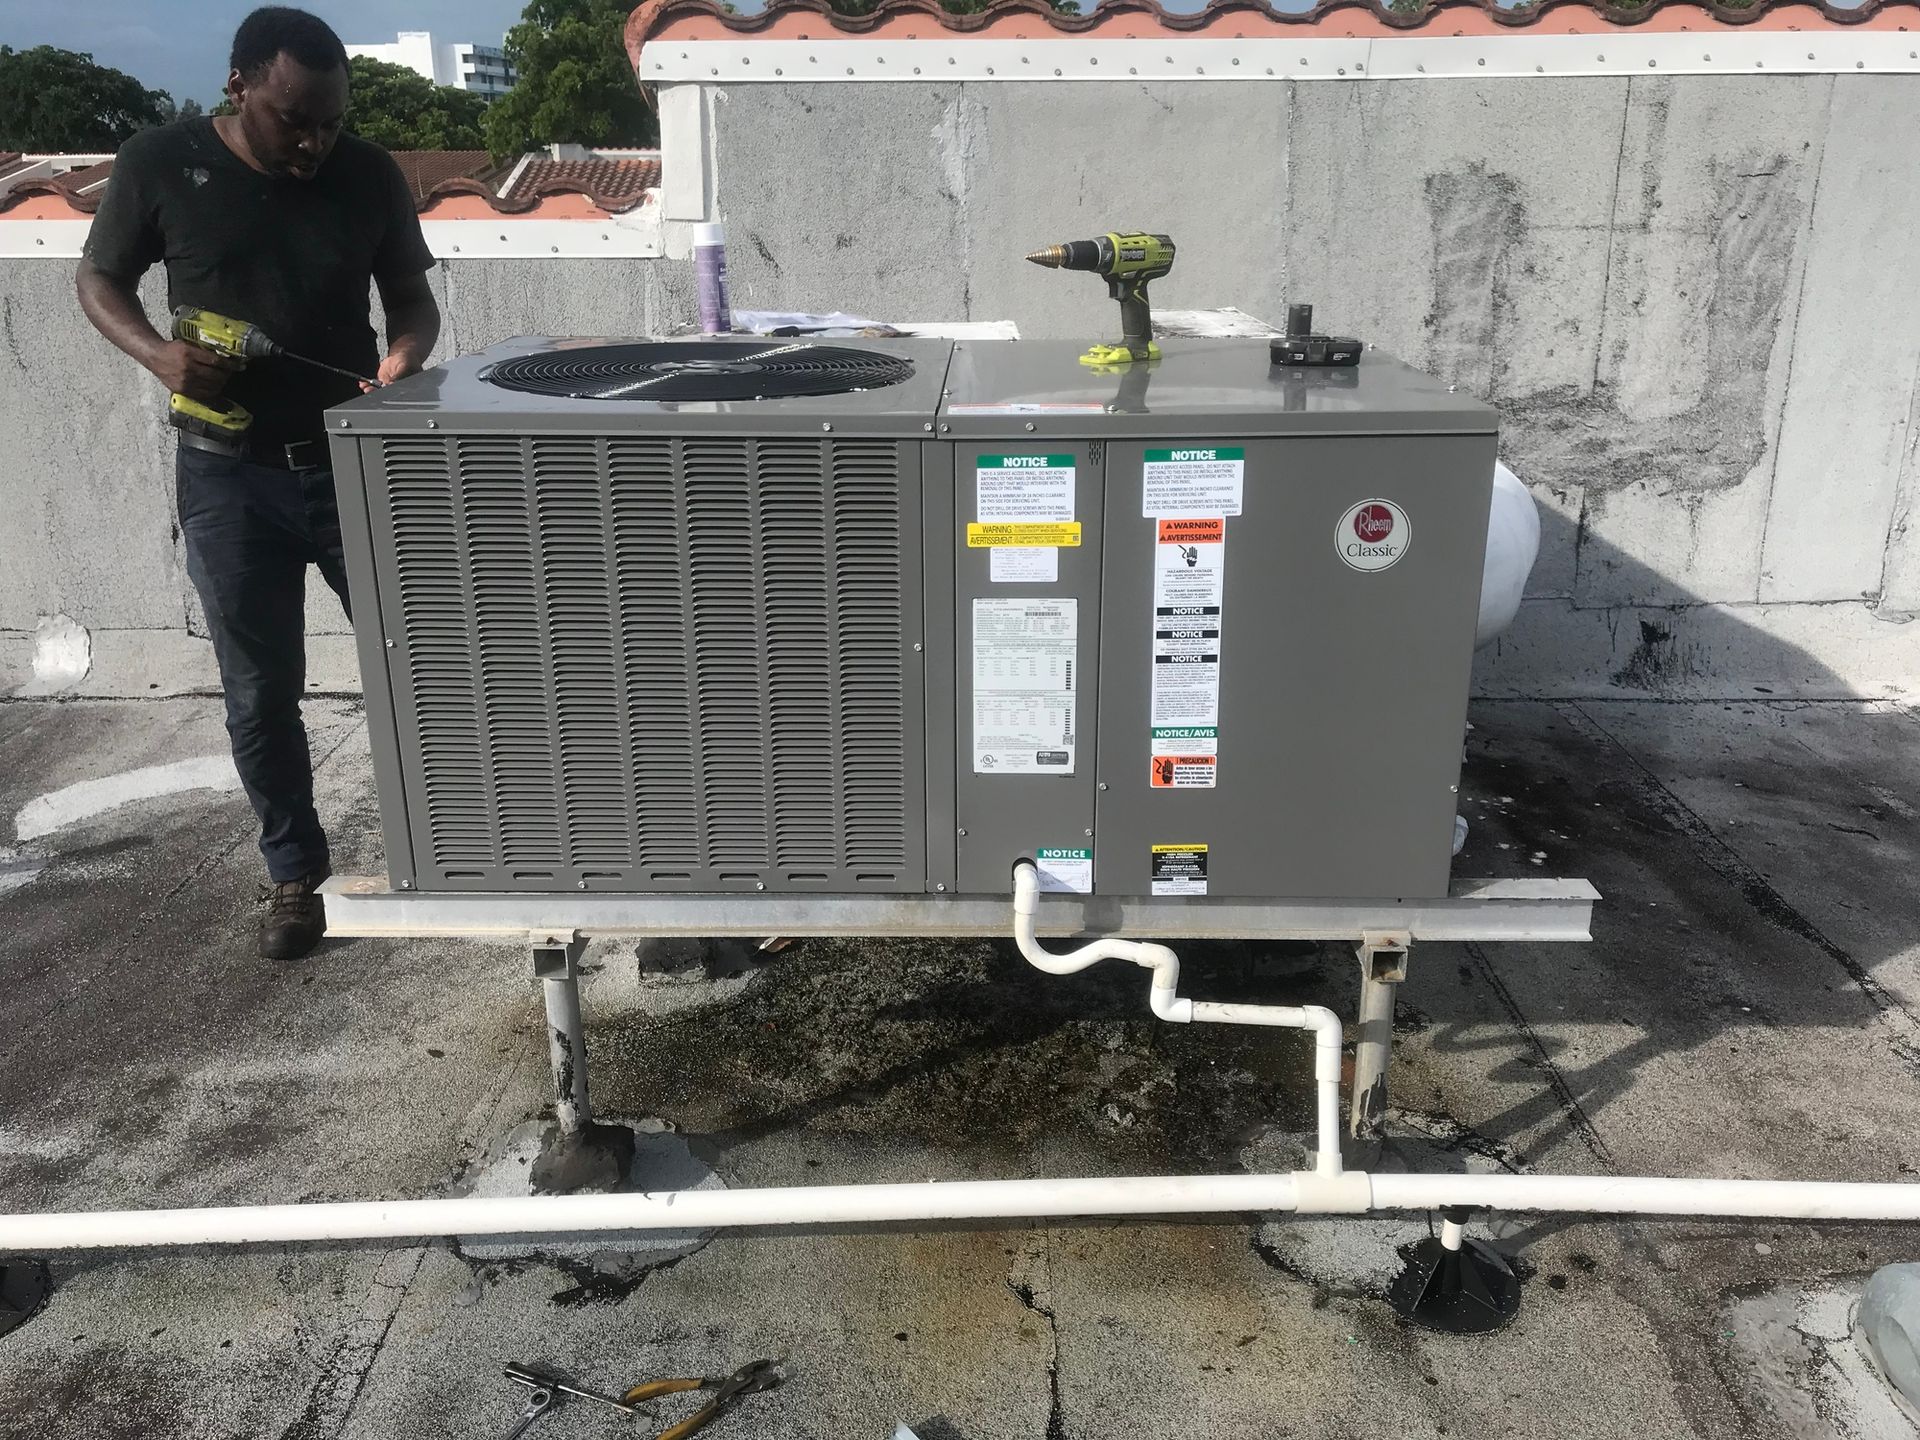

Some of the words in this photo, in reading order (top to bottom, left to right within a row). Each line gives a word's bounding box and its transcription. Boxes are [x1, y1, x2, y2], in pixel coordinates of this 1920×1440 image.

[1171, 450, 1216, 460] NOTICE
[1004, 457, 1048, 467] NOTICE
[1358, 506, 1392, 537] Rheem
[1346, 544, 1397, 557] Classic
[1156, 729, 1215, 737] NOTICE/AVIS
[1043, 850, 1086, 858] NOTICE
